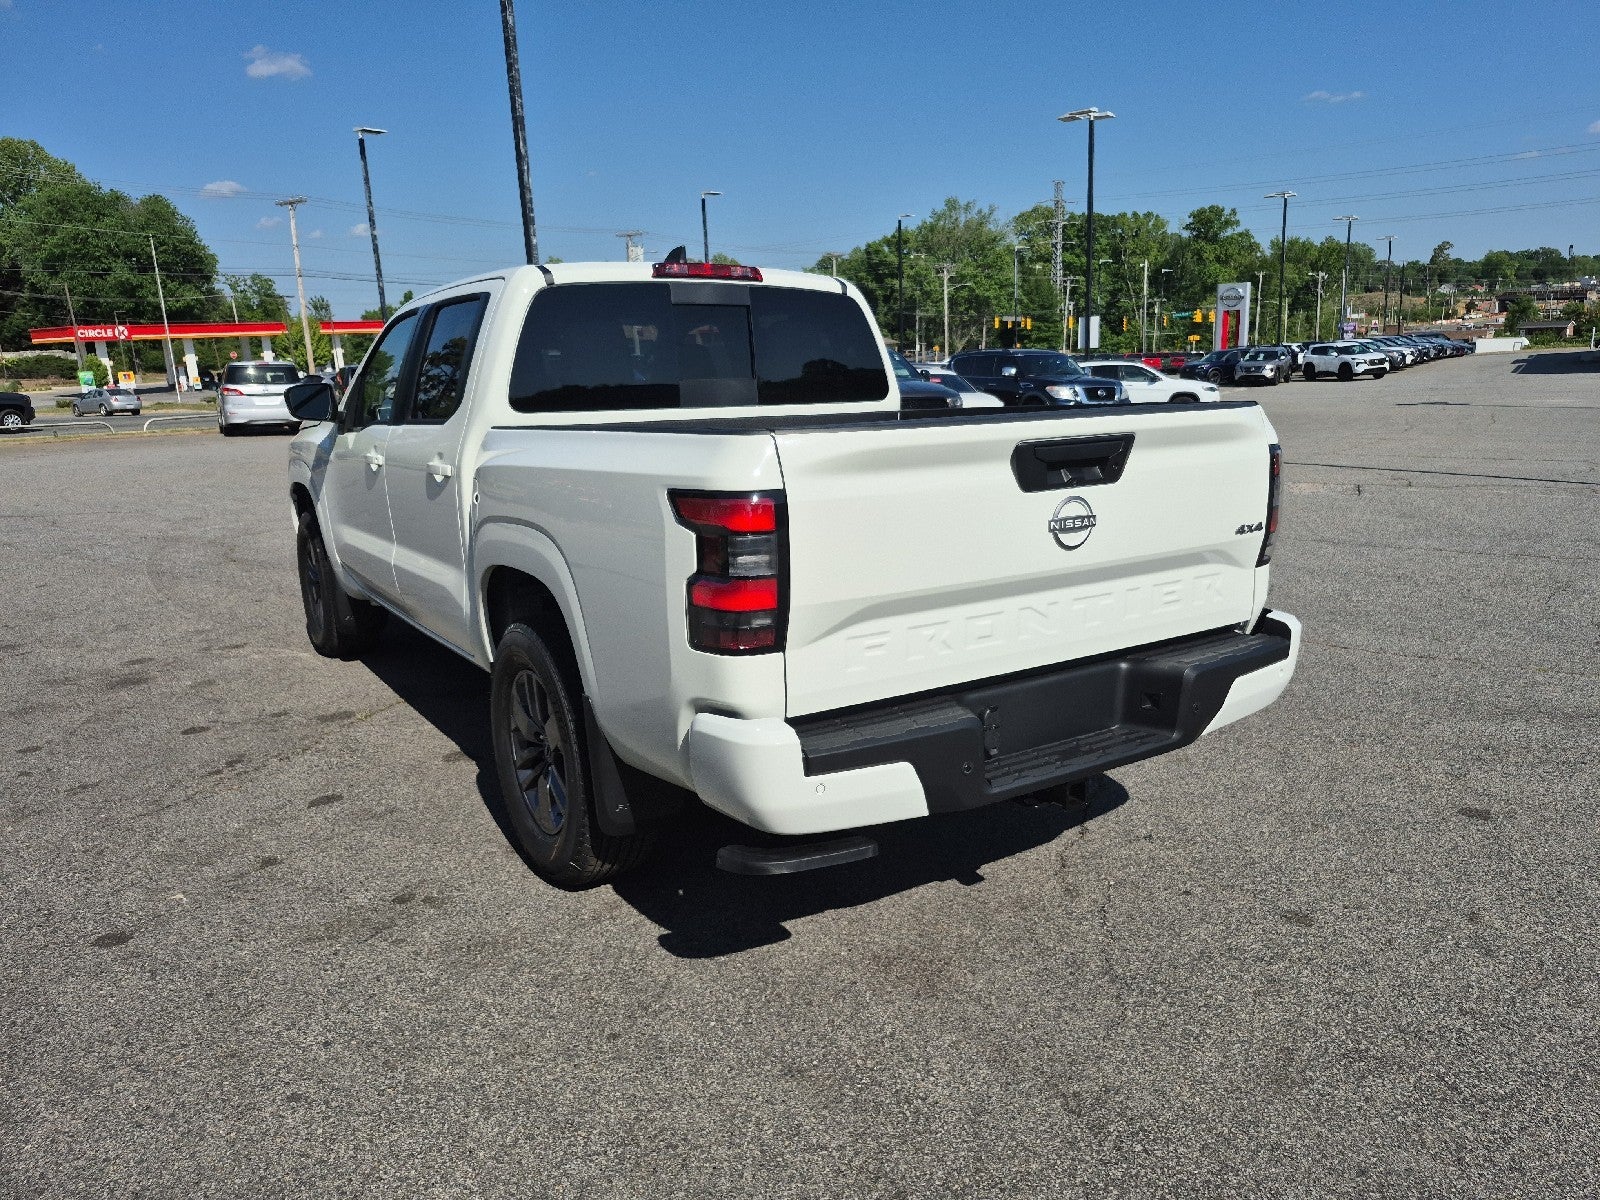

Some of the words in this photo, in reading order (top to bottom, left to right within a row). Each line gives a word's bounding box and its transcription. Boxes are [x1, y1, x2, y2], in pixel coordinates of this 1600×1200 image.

[78, 329, 113, 338] CIRCLE
[1050, 517, 1096, 530] NISSAN
[845, 572, 1224, 672] FRONTIER
